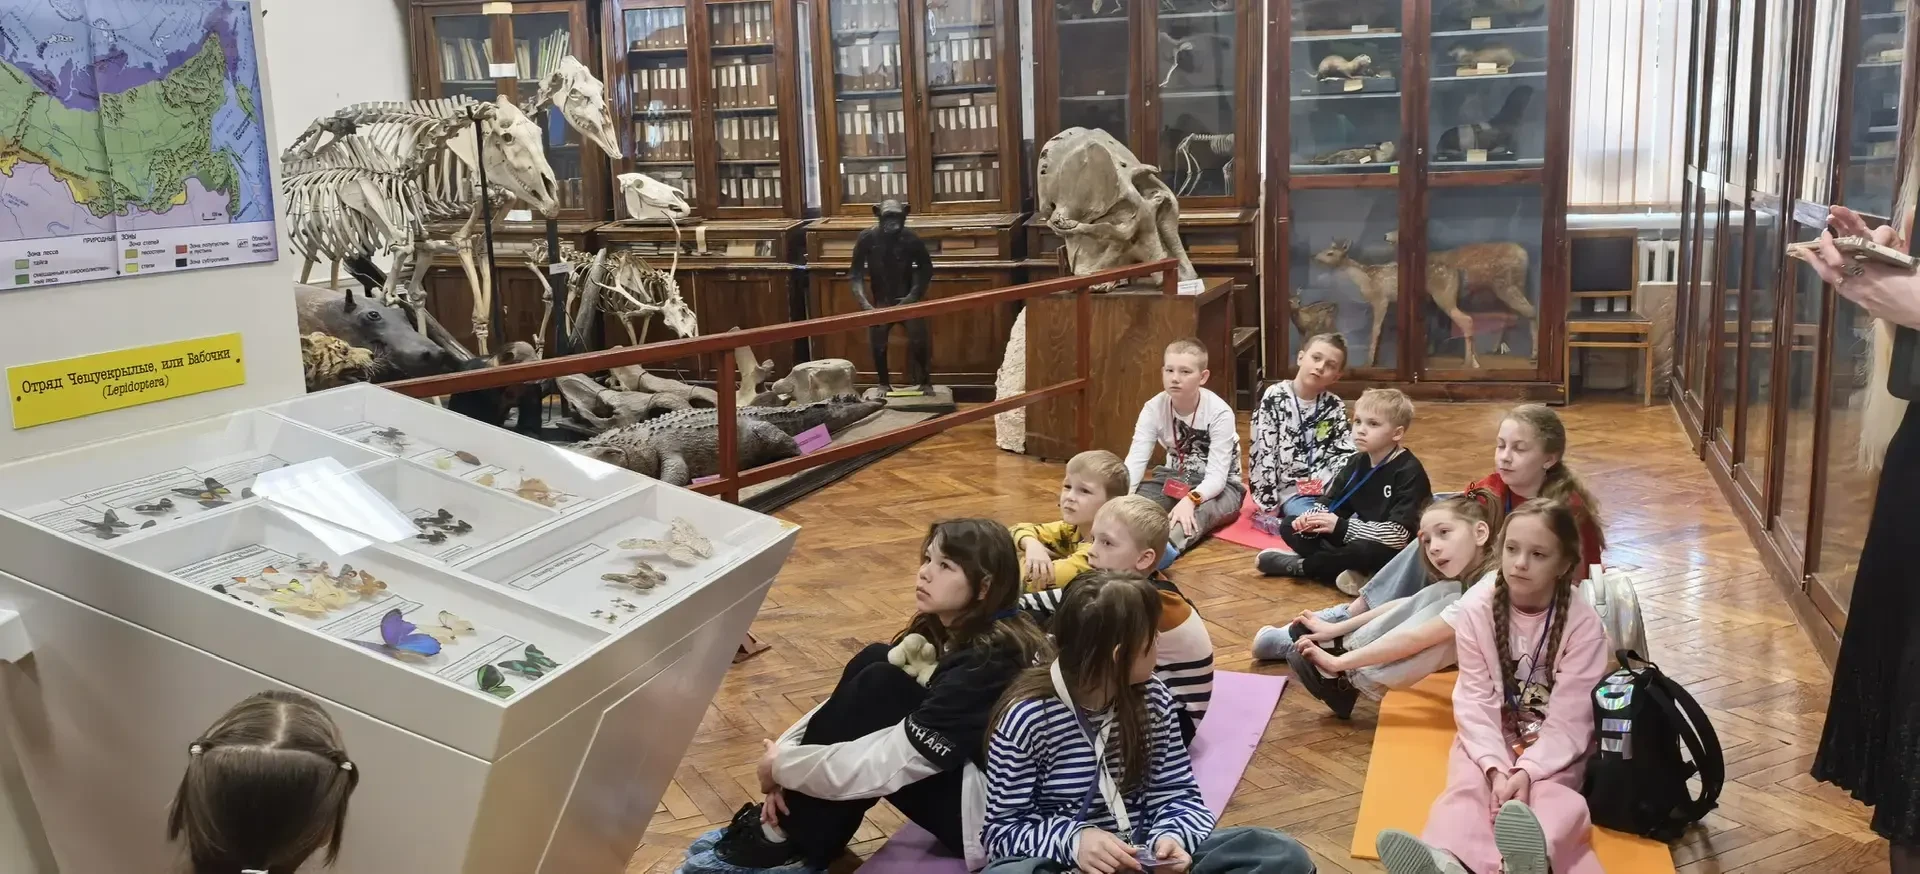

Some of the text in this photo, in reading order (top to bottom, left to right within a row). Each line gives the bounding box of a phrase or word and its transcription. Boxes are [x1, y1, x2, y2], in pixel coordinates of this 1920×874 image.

[83, 235, 116, 243] ПРИРОДНЫЕ
[22, 348, 231, 394] Отряд Чешуекрылые, или Бабочки
[102, 374, 169, 399] (Lepidoptera)
[1383, 485, 1392, 498] G
[923, 737, 952, 756] ART
